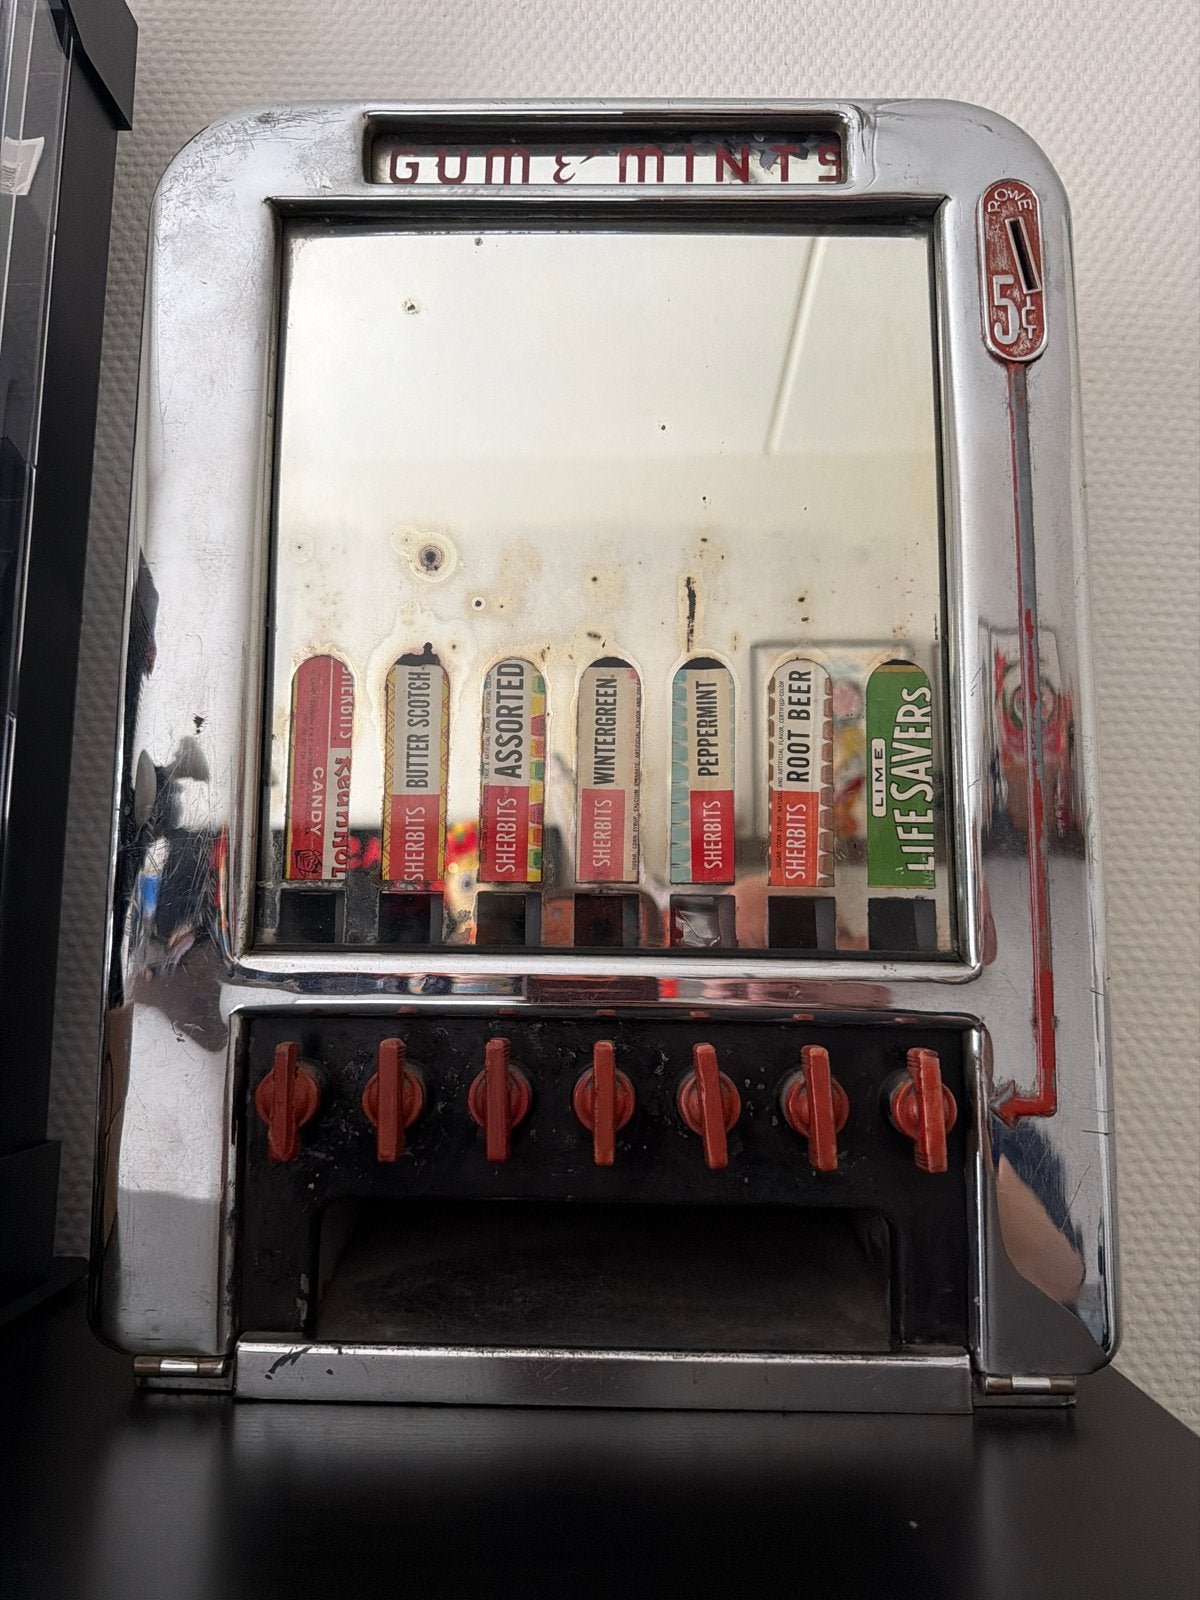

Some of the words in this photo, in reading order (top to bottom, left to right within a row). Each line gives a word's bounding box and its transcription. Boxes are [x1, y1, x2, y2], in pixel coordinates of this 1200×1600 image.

[389, 146, 529, 184] GUM
[618, 144, 842, 184] MINTS
[987, 188, 1033, 213] ROWE
[407, 672, 431, 728] SCOTCH
[494, 662, 524, 779] ASSORTED
[695, 680, 719, 777] PEPPERMINT
[787, 670, 812, 721] BEER
[405, 733, 429, 788] BUTTER
[593, 677, 618, 785] WINTERGREEN
[787, 729, 810, 783] ROOT
[890, 686, 934, 803] SAVERS
[311, 766, 324, 838] CANDY
[874, 748, 884, 807] LIME
[404, 807, 425, 880] SHERBITS
[495, 797, 517, 873] SHERBITS
[592, 799, 612, 867] SHERBITS
[702, 800, 723, 869] SHERBITS
[785, 803, 807, 879] SHERBITS
[893, 809, 935, 872] LIFE
